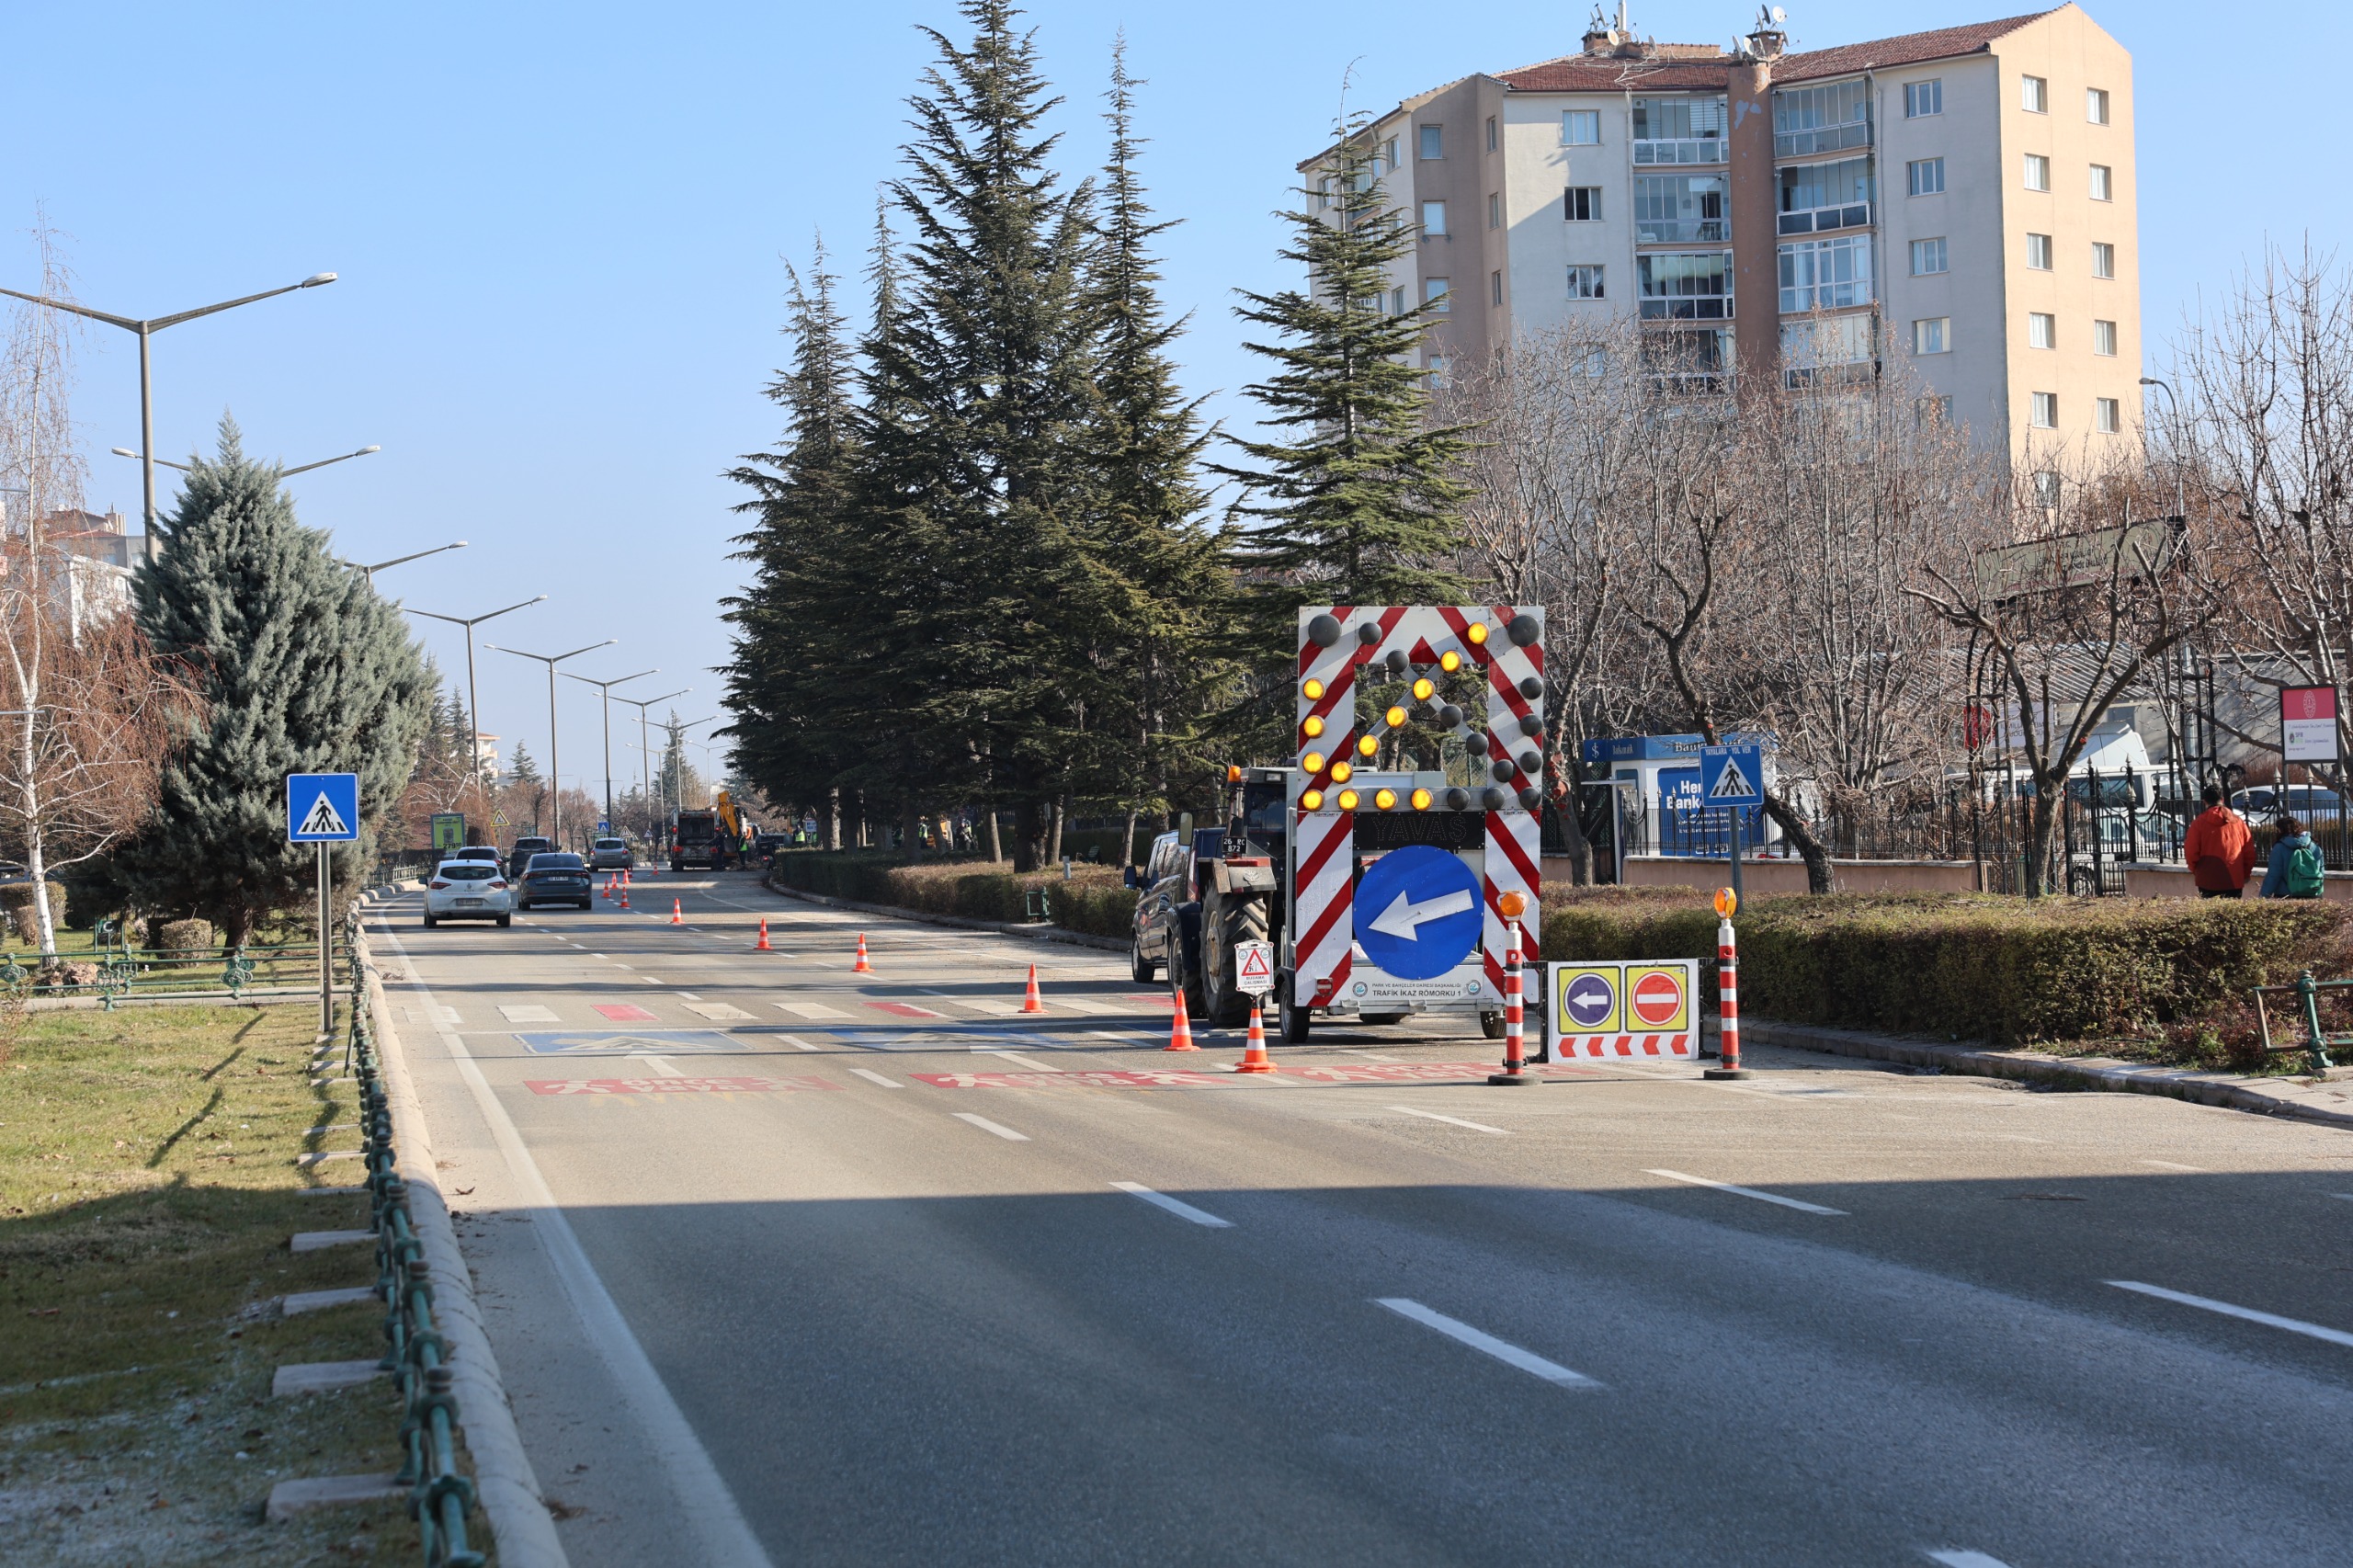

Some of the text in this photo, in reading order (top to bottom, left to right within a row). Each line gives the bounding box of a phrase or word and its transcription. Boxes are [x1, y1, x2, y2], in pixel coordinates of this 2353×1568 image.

[1705, 747, 1728, 756] YAYALARA
[1731, 746, 1741, 755] YOL
[1742, 745, 1752, 754] VER
[1418, 989, 1456, 997] RÖMORKU
